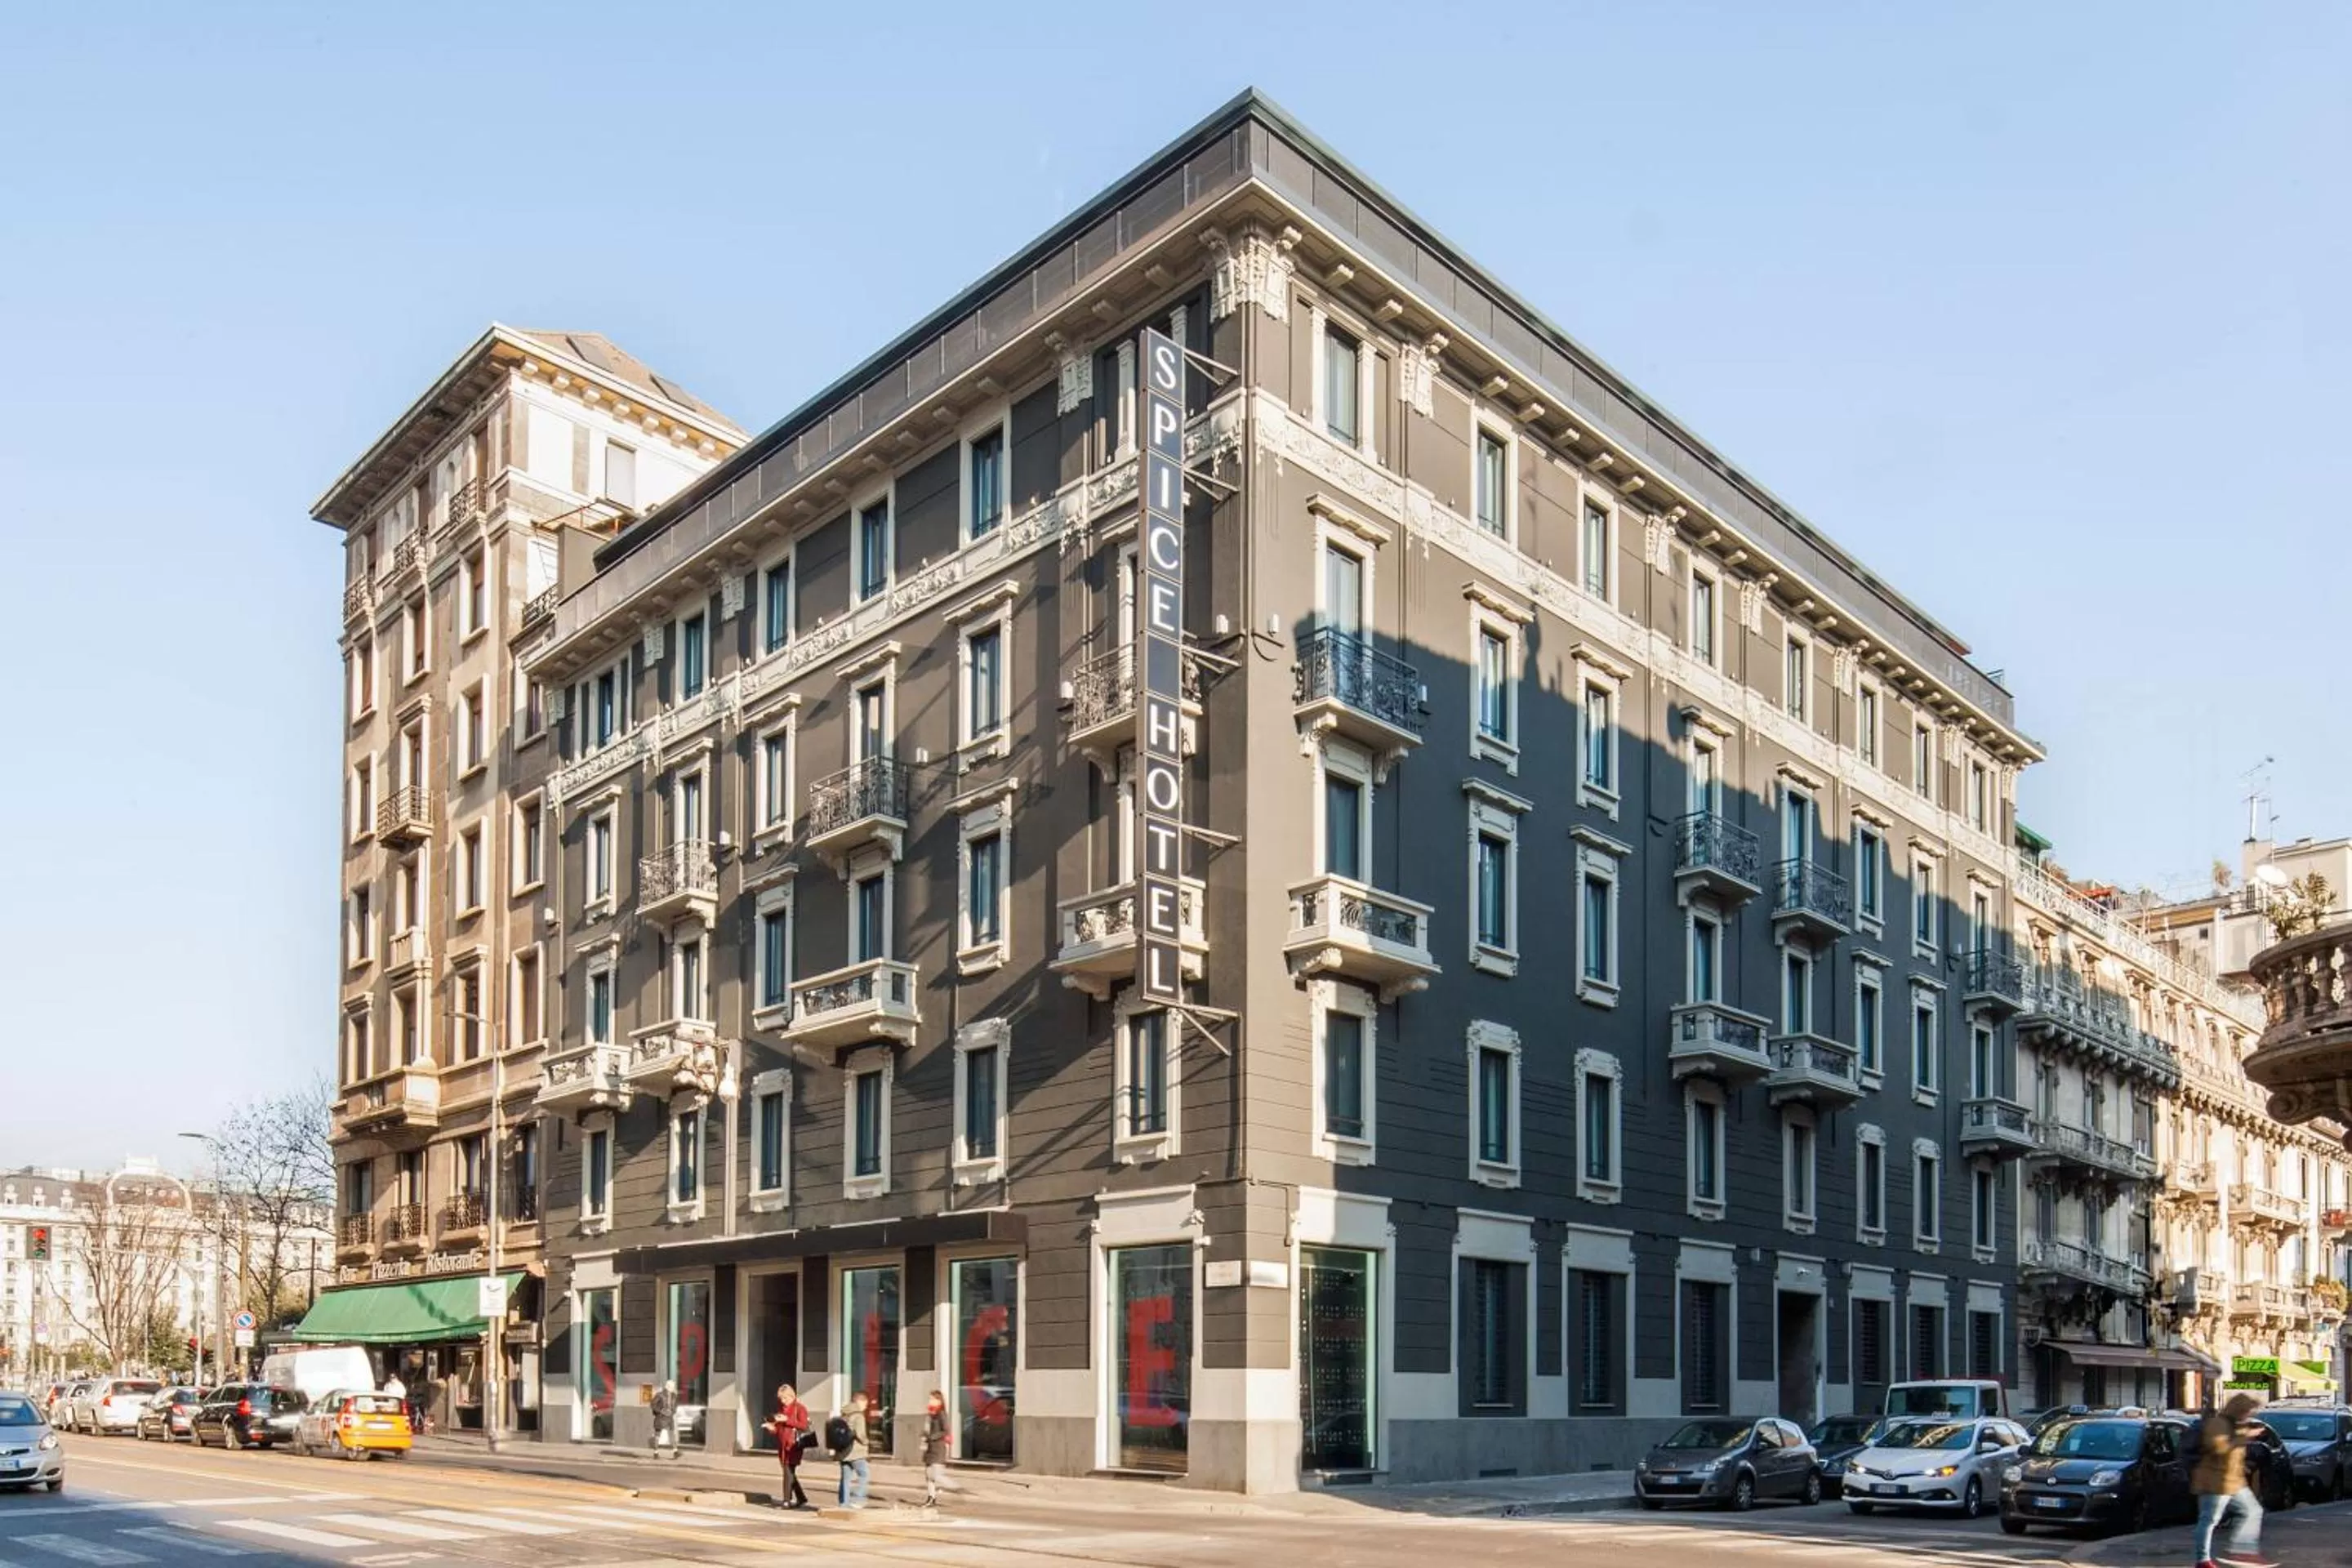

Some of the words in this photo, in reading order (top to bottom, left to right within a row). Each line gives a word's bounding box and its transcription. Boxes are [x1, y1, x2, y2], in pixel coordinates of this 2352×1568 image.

[1150, 345, 1179, 632] SPICE
[1147, 703, 1178, 993] HOTEL
[372, 1257, 411, 1280] Pizzeria
[426, 1248, 483, 1273] Ristorante
[2236, 1358, 2277, 1371] PIZZA
